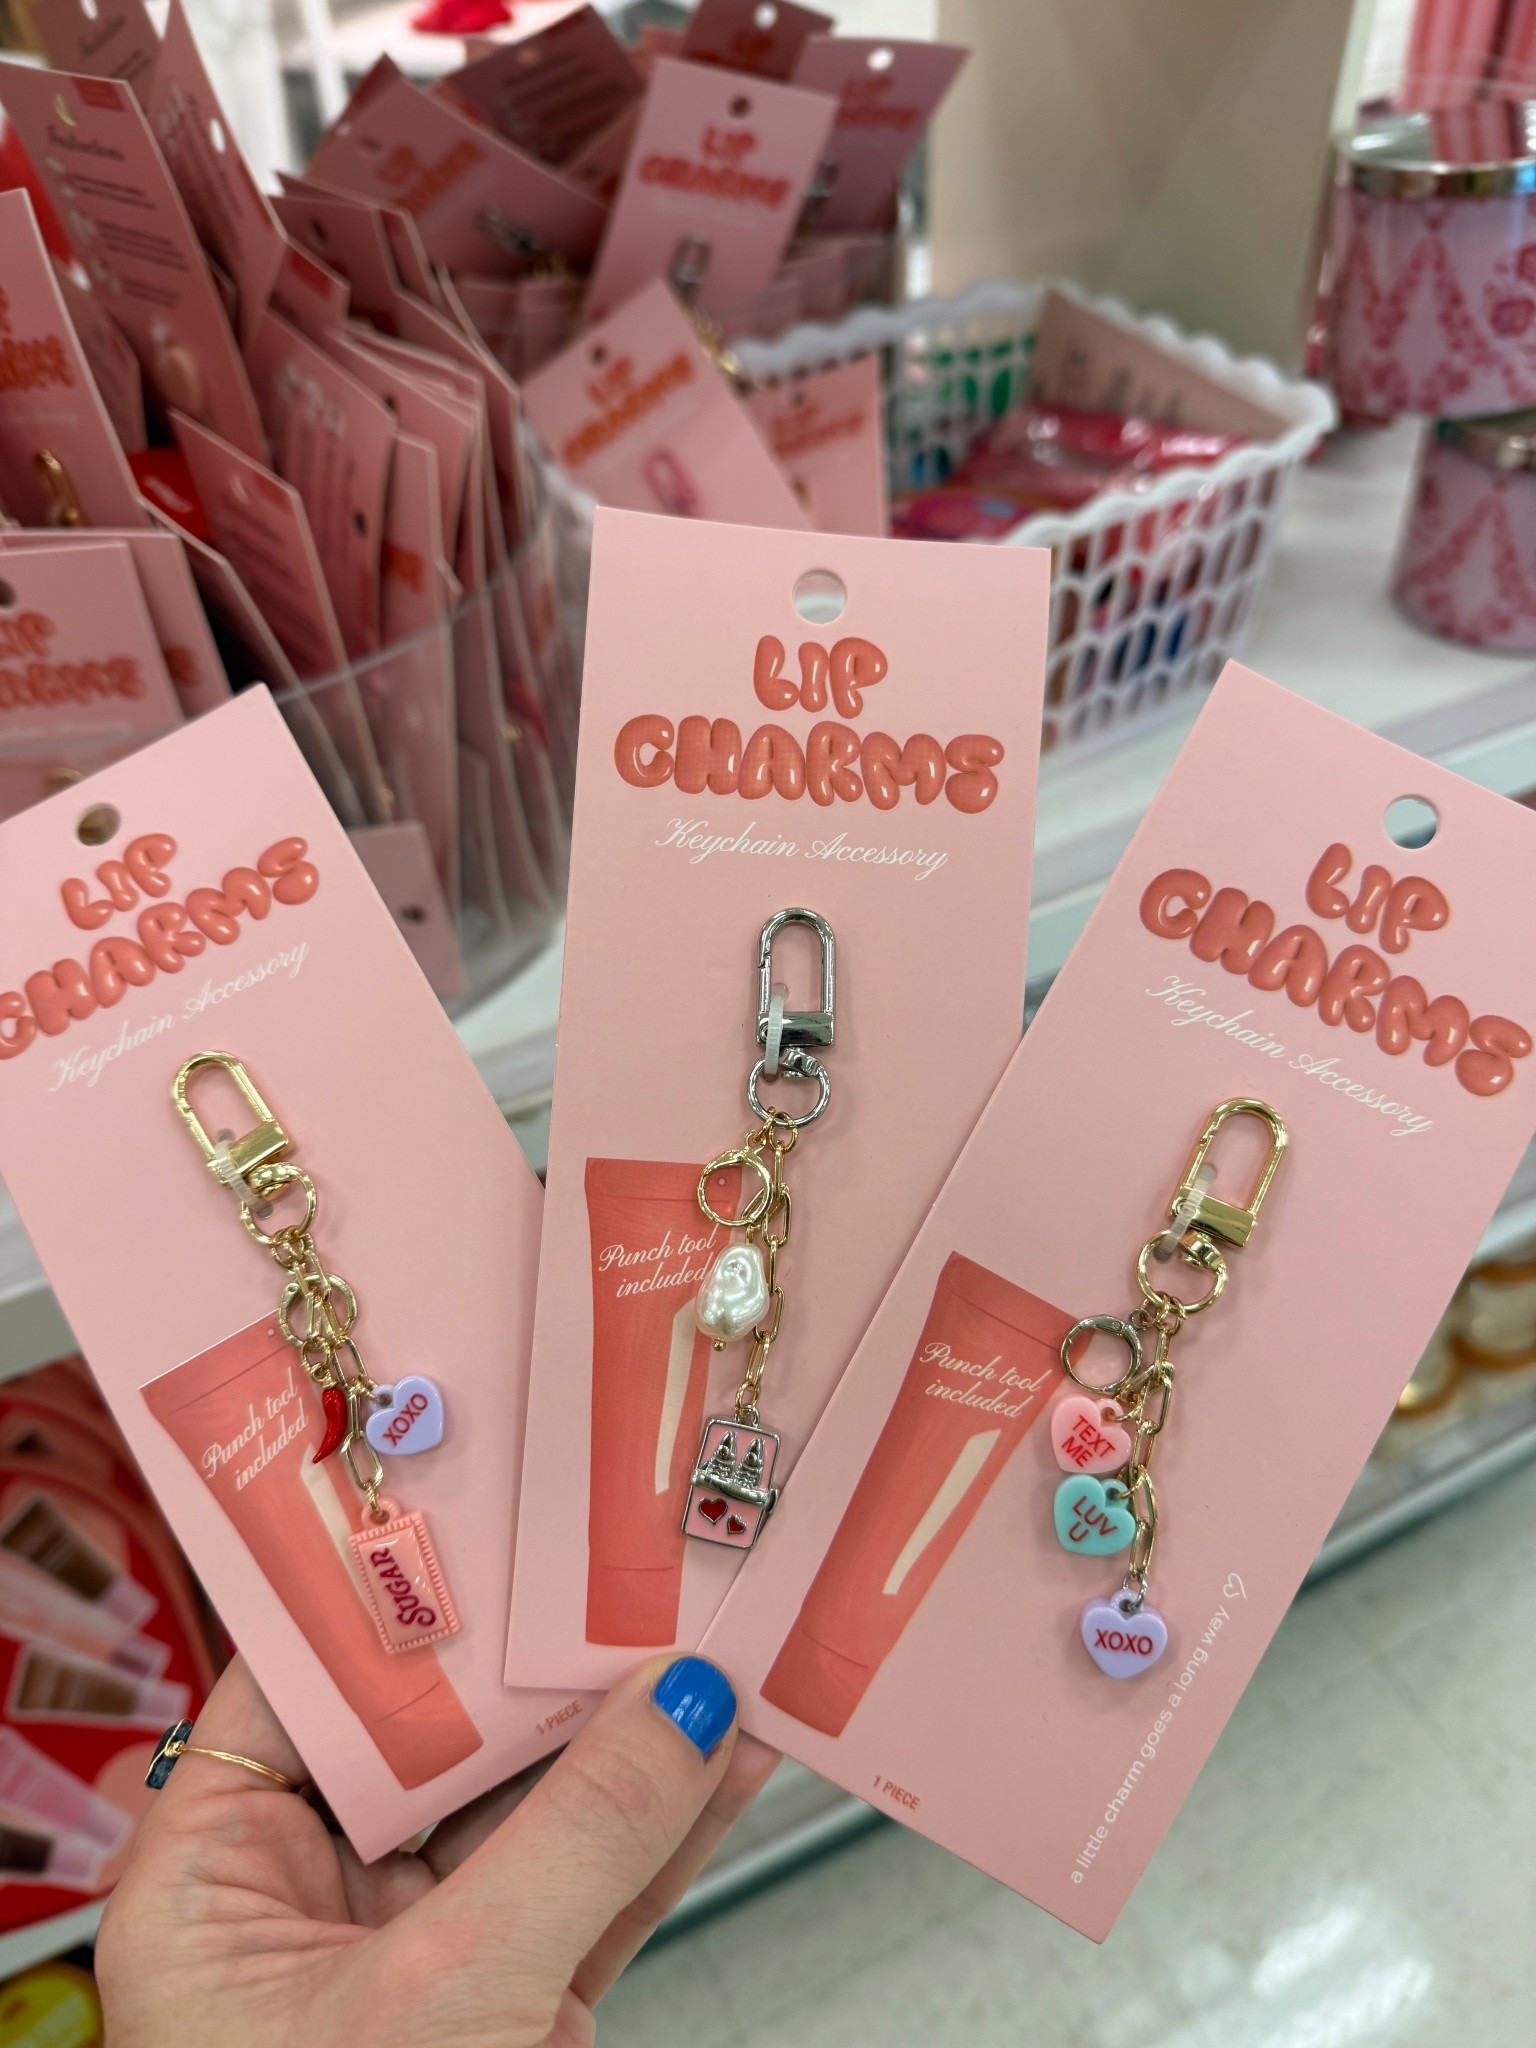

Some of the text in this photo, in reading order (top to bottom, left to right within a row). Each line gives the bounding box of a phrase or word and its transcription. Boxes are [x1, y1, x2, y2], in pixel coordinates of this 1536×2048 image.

[753, 634, 889, 720] LIP
[613, 713, 1005, 815] CHARMS
[60, 832, 178, 931] LIP
[655, 817, 949, 882] Keychain Accessory
[1305, 842, 1450, 955] LIP
[0, 836, 320, 1061] CHARMS
[1138, 868, 1534, 1098] CHARMS
[47, 940, 310, 1093] Keychain Accessory
[1145, 974, 1436, 1138] Keychain Accessory
[598, 1222, 719, 1272] Punch tool
[616, 1251, 715, 1299] included
[919, 1342, 1053, 1393] Punch tool
[924, 1378, 1035, 1419] included
[202, 1365, 300, 1480] Punch tool
[233, 1396, 309, 1493] included
[382, 1391, 429, 1447] XOXO
[1060, 1435, 1094, 1468] ME
[1071, 1414, 1117, 1459] TEXT
[1067, 1521, 1090, 1543] U
[1072, 1495, 1119, 1537] LUV
[370, 1546, 437, 1627] SUGAR
[1093, 1628, 1154, 1656] XOXO
[535, 1699, 583, 1735] 1 PIECE
[1070, 1603, 1231, 1885] a little charm goes a long way
[873, 1774, 921, 1811] 1 PIECE
